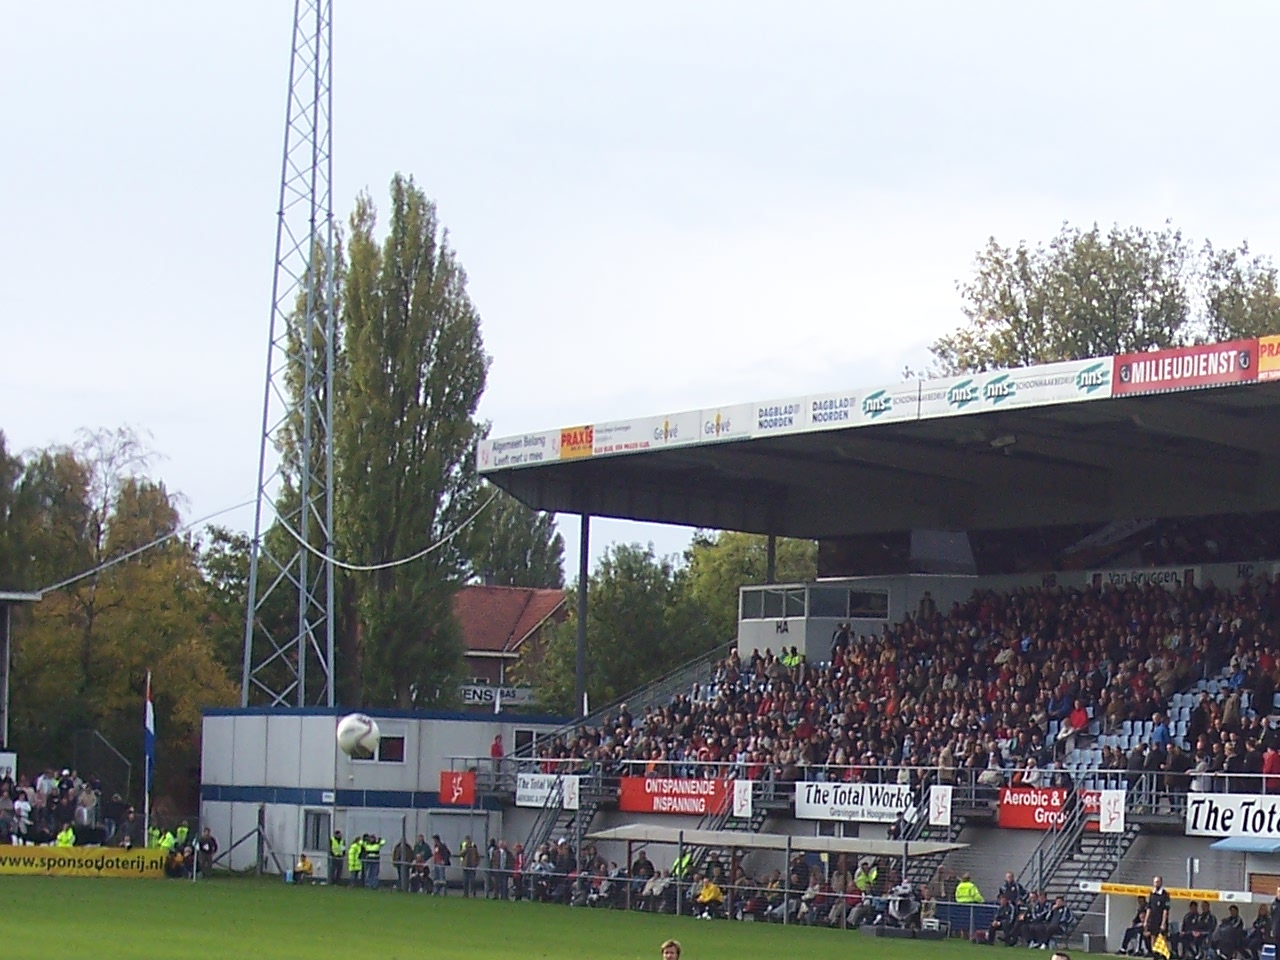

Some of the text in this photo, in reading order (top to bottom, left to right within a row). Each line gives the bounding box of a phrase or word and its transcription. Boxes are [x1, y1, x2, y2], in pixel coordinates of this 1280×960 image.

[1131, 350, 1238, 384] MILIEUDIENST
[987, 383, 1010, 398] nns
[1079, 371, 1103, 387] nns
[812, 397, 849, 412] DAGBLAD
[865, 398, 886, 413] nns
[951, 387, 973, 402] nns
[758, 404, 794, 419] DAGBLAD
[812, 409, 849, 423] NOORDEN
[758, 417, 794, 430] NOORDEN
[561, 428, 594, 448] PRAXIS
[776, 621, 789, 634] HA
[645, 779, 715, 795] ONTSPANNENDE
[805, 784, 830, 804] The
[833, 785, 864, 806] Total
[653, 797, 706, 812] INSPANNING
[1003, 789, 1049, 806] Aerobic
[1051, 791, 1061, 806] &
[1191, 799, 1235, 832] The
